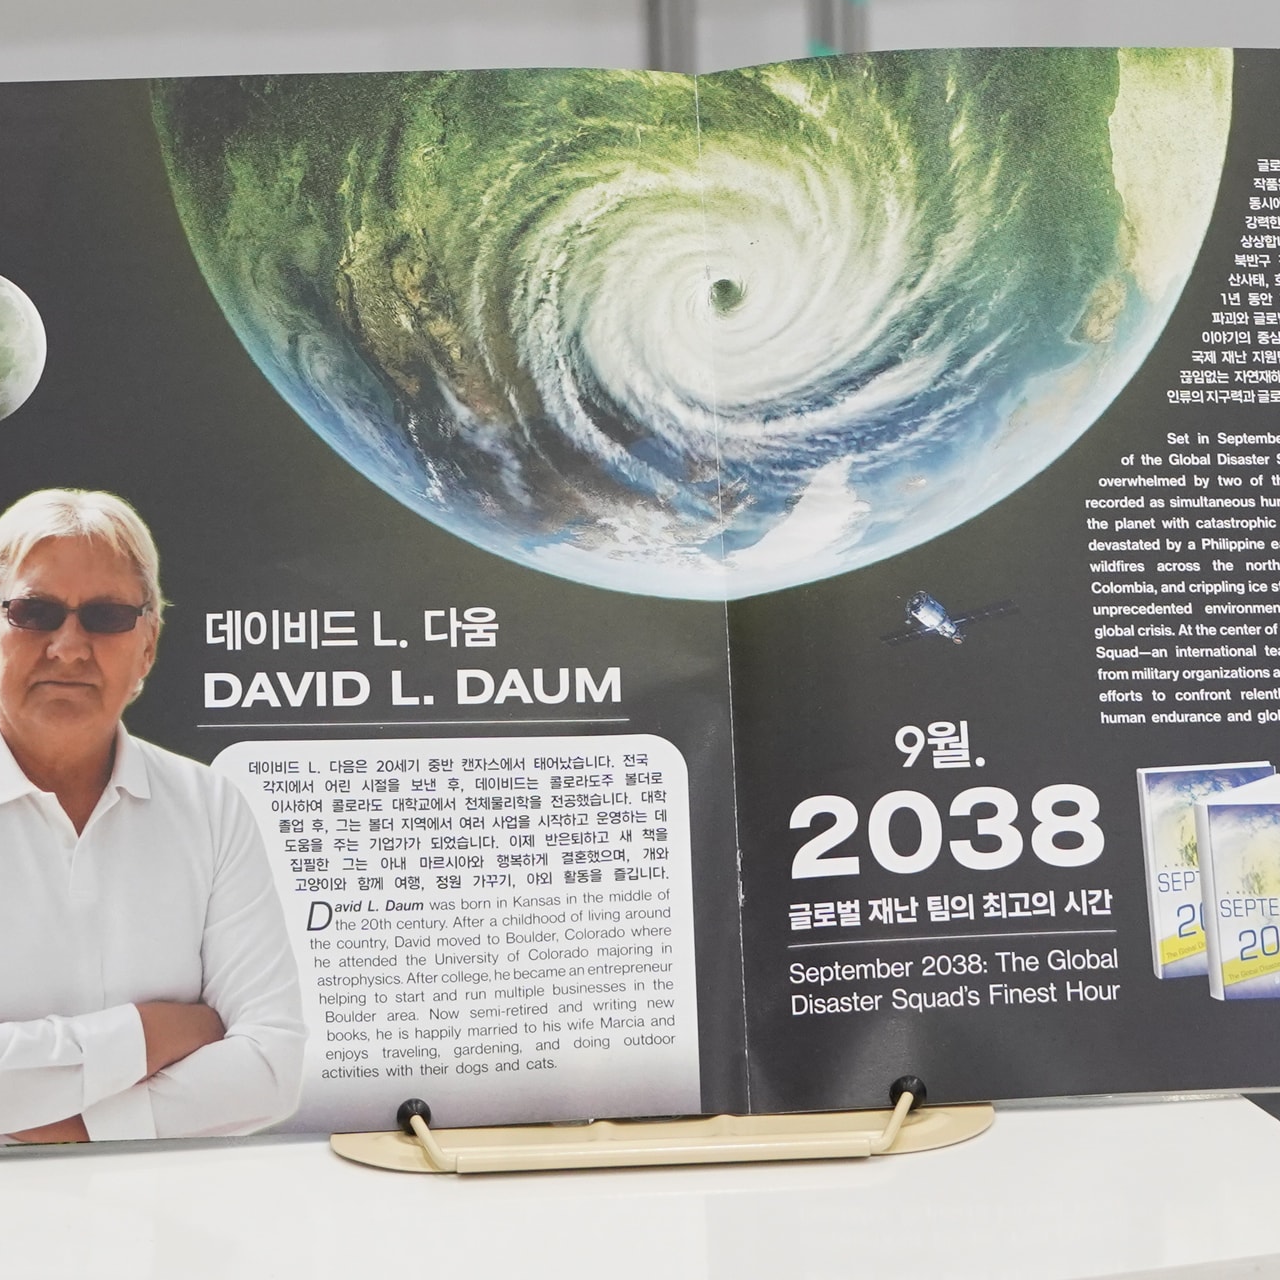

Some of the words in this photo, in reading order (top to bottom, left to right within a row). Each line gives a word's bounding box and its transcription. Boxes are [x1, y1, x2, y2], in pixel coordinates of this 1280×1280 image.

[1166, 432, 1191, 445] Set
[1196, 431, 1210, 445] in
[205, 608, 359, 651] 데이비드
[373, 610, 409, 649] L.
[423, 606, 500, 648] 다움
[203, 670, 371, 709] DAVID
[391, 669, 435, 706] L.
[456, 666, 622, 705] DAUM
[1100, 711, 1147, 724] human
[1150, 710, 1222, 724] endurance
[1226, 709, 1253, 723] and
[894, 720, 986, 770] 9월.
[248, 760, 300, 776] 데이비드
[308, 761, 321, 775] L.
[329, 759, 368, 774] 다음은
[376, 758, 420, 773] 20세기
[427, 758, 455, 773] 중반
[461, 757, 526, 772] 캔자스에서
[533, 754, 615, 771] 태어났습니다.
[622, 753, 649, 768] 전국
[788, 782, 1106, 880] 2038
[335, 919, 357, 931] the
[360, 918, 392, 931] 20th
[396, 917, 447, 932] century.
[452, 915, 485, 929] After
[489, 917, 498, 928] a
[501, 911, 566, 927] childhood
[570, 909, 583, 923] of
[586, 909, 622, 926] living
[625, 906, 671, 920] around
[788, 899, 862, 931] 글로벌
[867, 895, 920, 925] 재난
[926, 893, 975, 923] 팀의
[982, 889, 1057, 919] 최고의
[1063, 888, 1114, 917] 시간
[789, 957, 914, 987] September
[921, 953, 988, 977] 2038:
[994, 951, 1040, 973] The
[1047, 947, 1119, 971] Global
[791, 991, 884, 1016] Disaster
[891, 985, 981, 1014] Squad's
[988, 982, 1058, 1006] Finest
[1065, 980, 1121, 1002] Hour
[321, 1065, 380, 1079] activities
[385, 1064, 414, 1077] with
[419, 1062, 450, 1076] their
[455, 1061, 489, 1076] dogs
[494, 1058, 520, 1073] and
[525, 1057, 558, 1071] cats.
